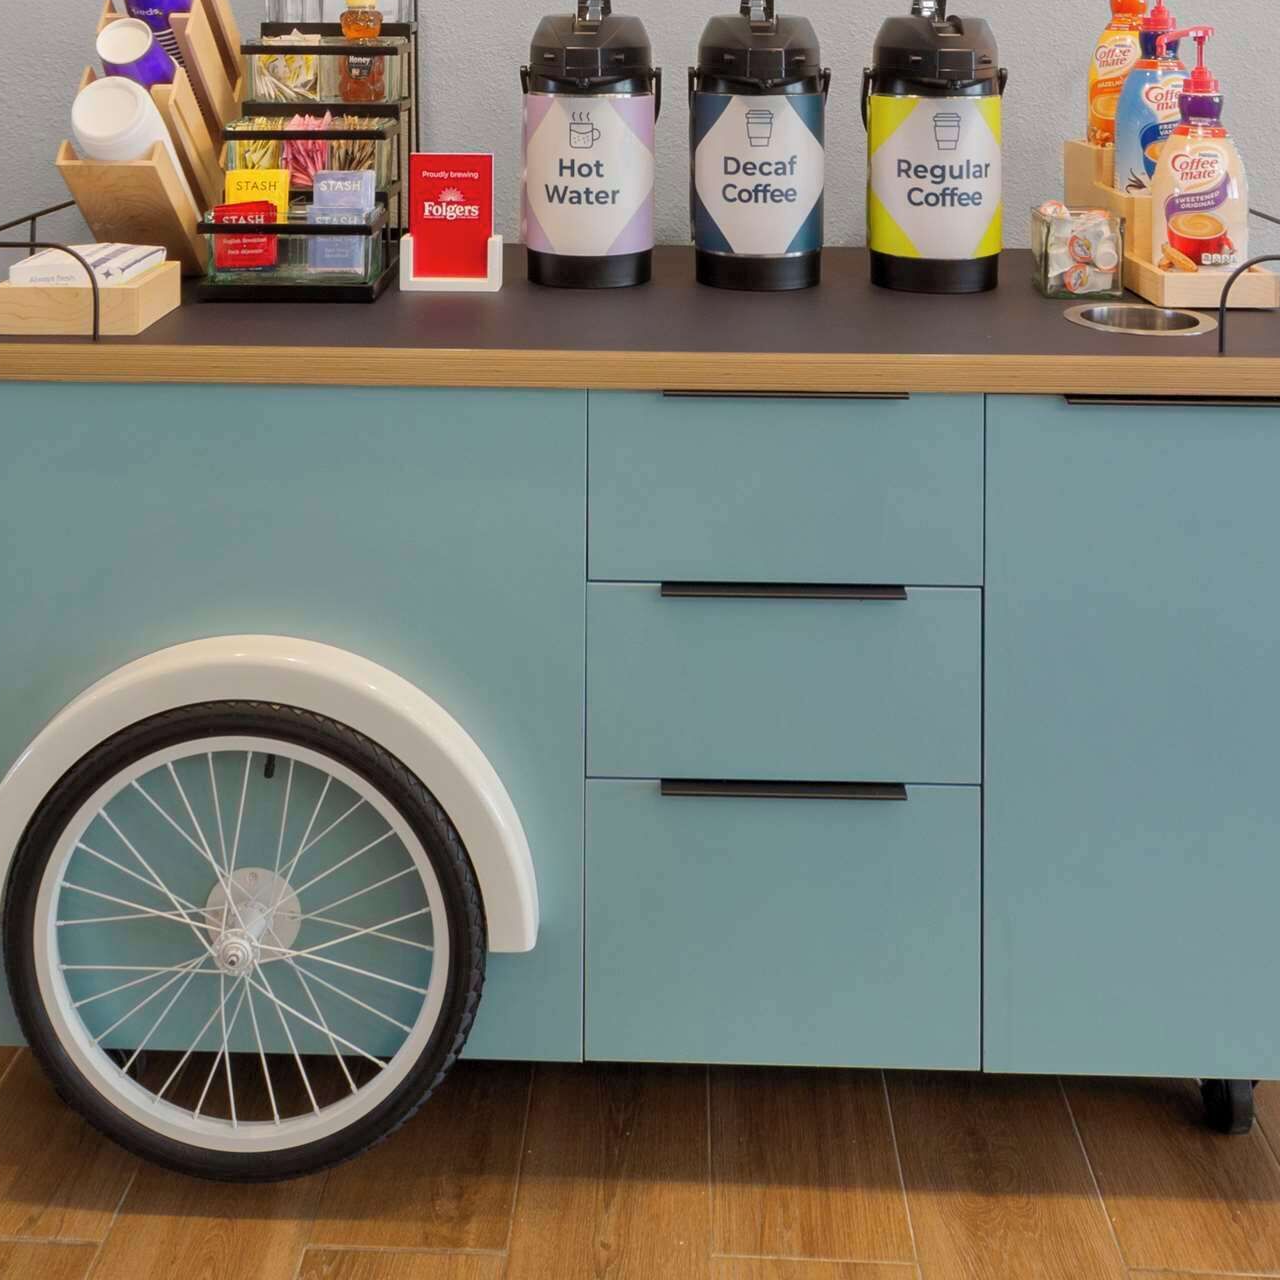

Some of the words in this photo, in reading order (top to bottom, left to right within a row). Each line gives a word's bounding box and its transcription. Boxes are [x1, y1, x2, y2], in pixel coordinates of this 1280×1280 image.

[1095, 45, 1131, 62] Coffee
[559, 158, 604, 178] Hot
[723, 155, 797, 176] Decaf
[1171, 153, 1218, 172] Coffee
[422, 170, 449, 179] Proudly
[450, 170, 479, 179] brewing
[897, 159, 991, 185] Regular
[1180, 170, 1216, 181] mate
[236, 180, 277, 192] STASH
[320, 180, 361, 192] STASH
[545, 184, 620, 205] Water
[722, 183, 797, 203] Coffee
[907, 187, 983, 207] Coffee
[1175, 191, 1220, 204] SWEETENED
[1181, 200, 1216, 209] ORIGINAL
[423, 201, 480, 220] Folgers
[222, 214, 265, 225] STASH
[315, 215, 357, 225] STASH
